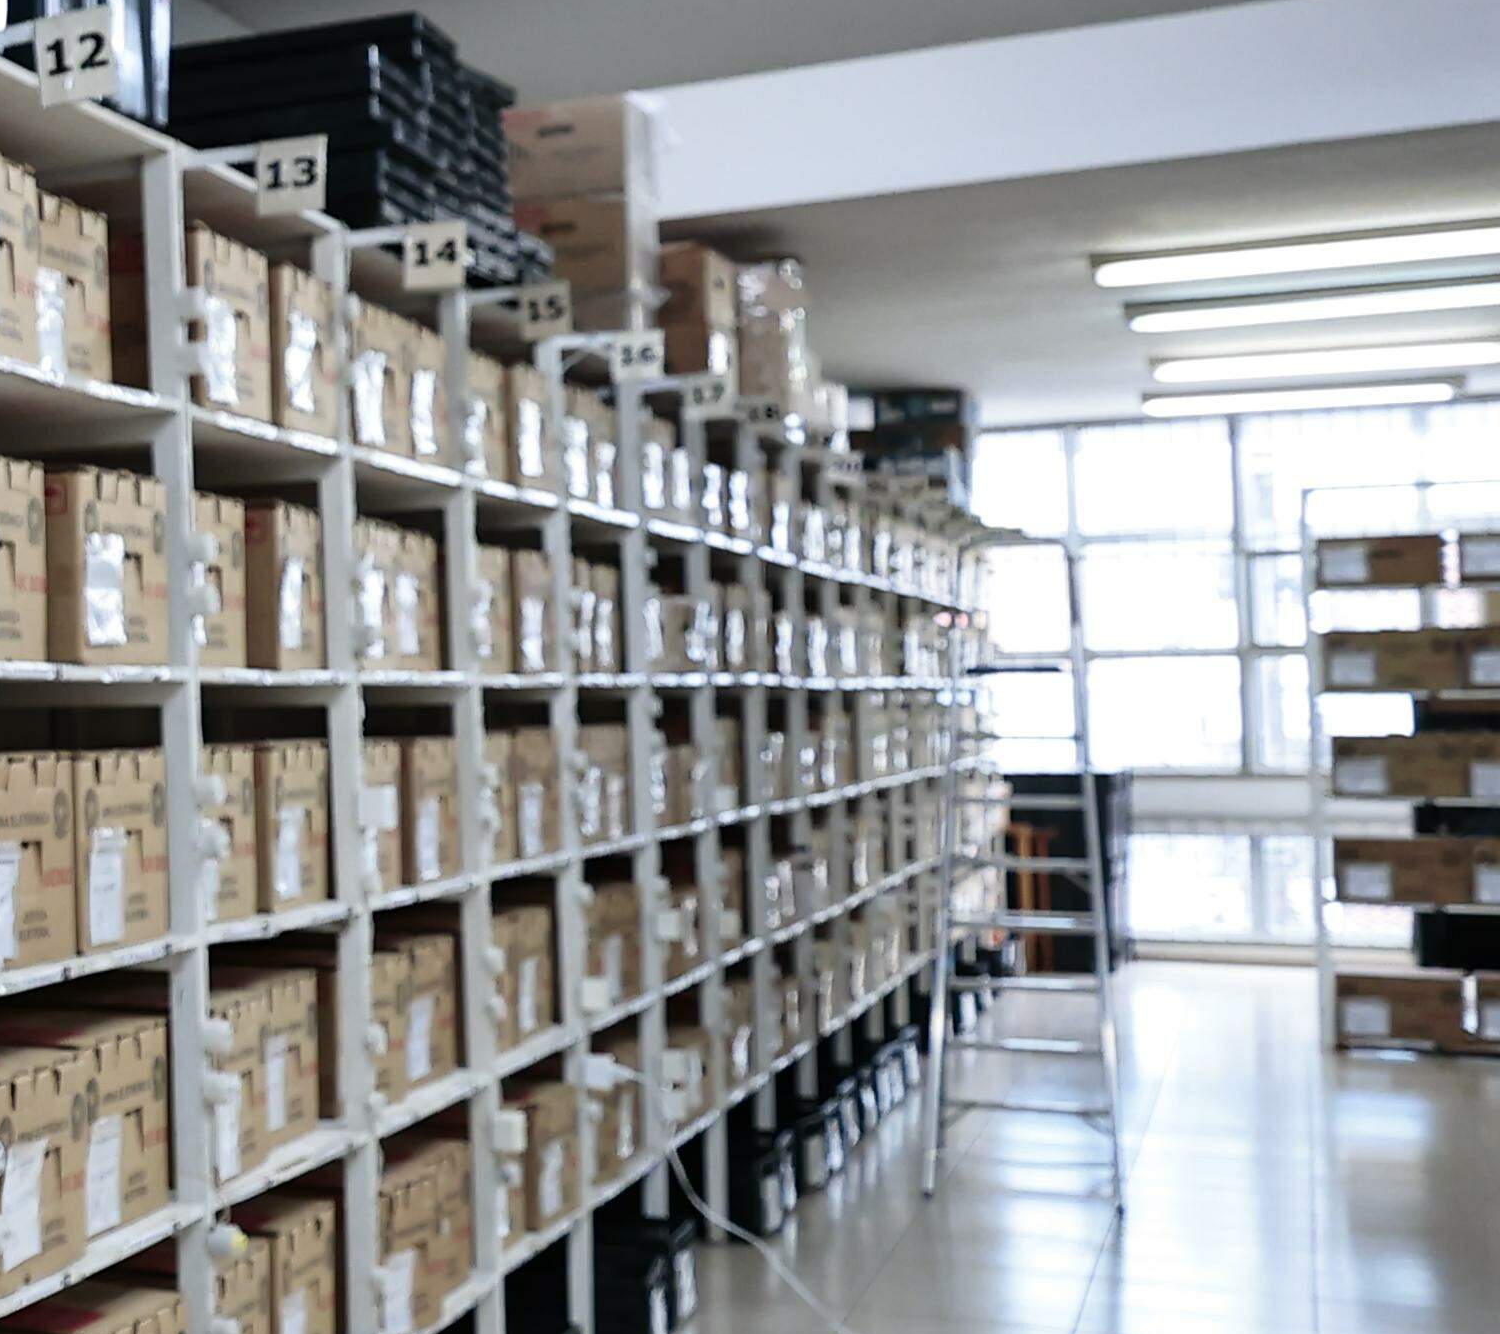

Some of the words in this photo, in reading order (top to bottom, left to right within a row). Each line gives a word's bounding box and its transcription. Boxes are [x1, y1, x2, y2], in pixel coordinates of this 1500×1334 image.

[46, 31, 109, 76] 12
[265, 158, 317, 191] 13
[412, 238, 460, 266] 14
